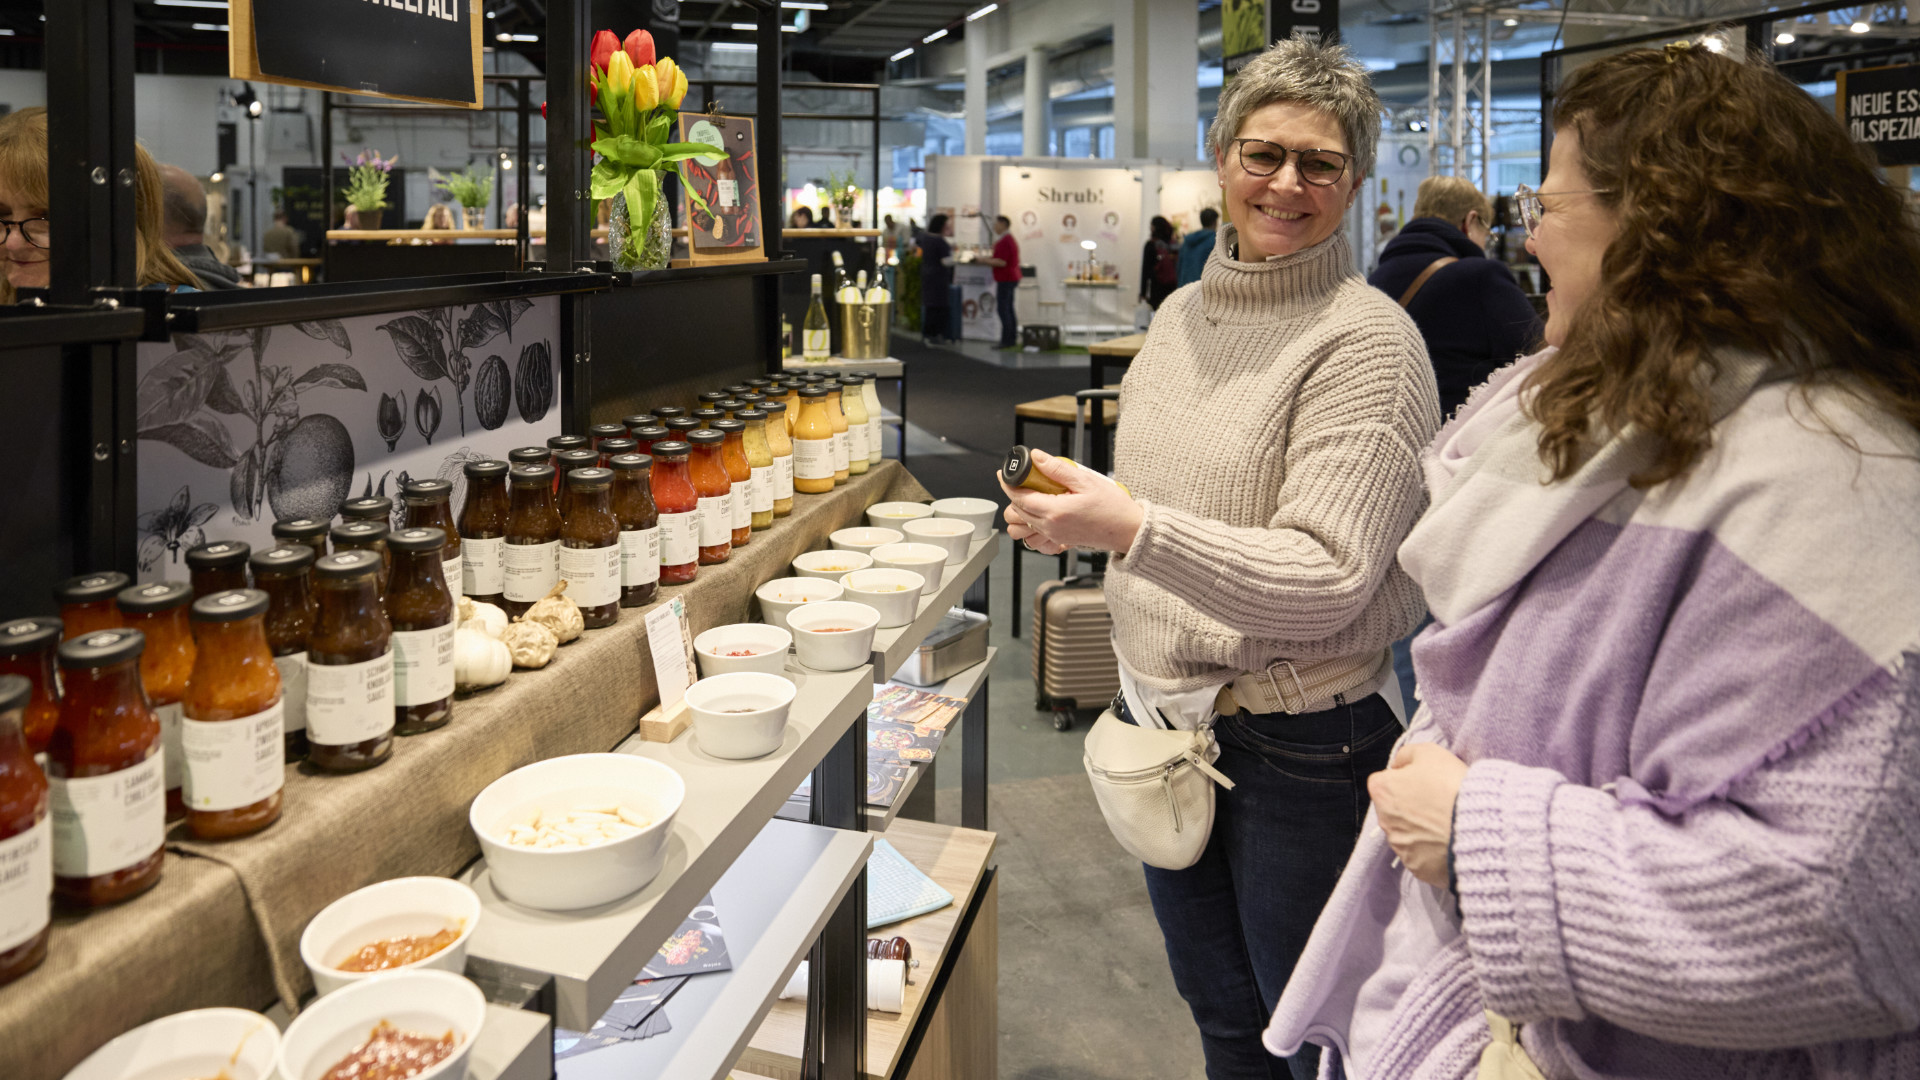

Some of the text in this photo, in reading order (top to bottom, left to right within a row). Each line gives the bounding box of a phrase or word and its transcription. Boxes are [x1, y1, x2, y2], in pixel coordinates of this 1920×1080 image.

[1850, 89, 1920, 117] NEUE ES
[1038, 187, 1103, 203] Shrub!
